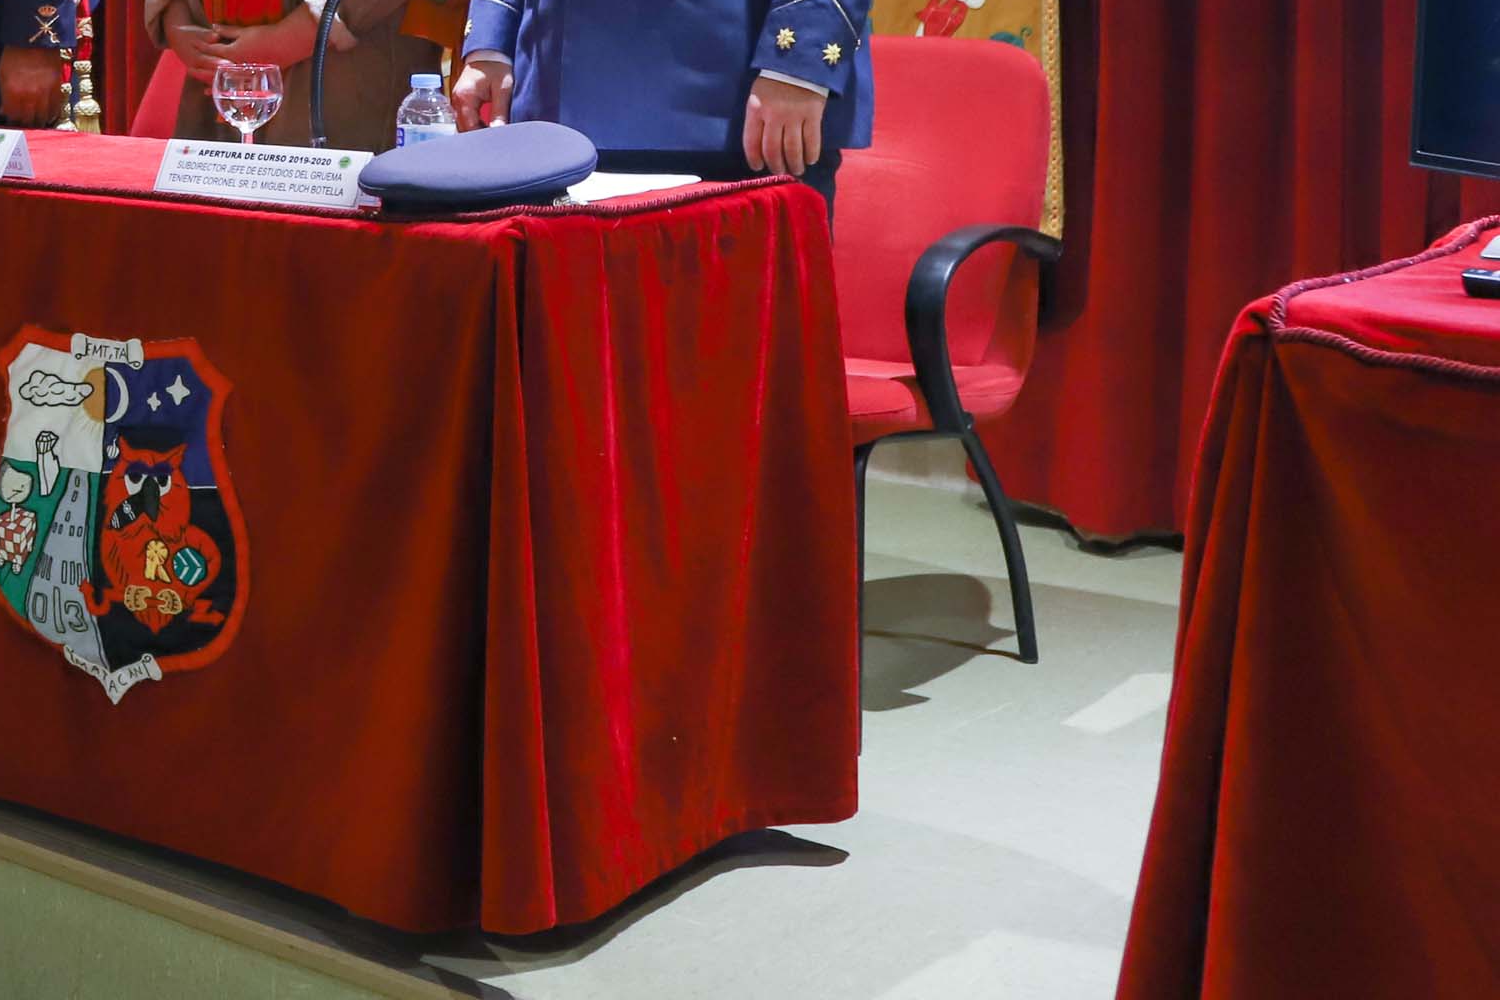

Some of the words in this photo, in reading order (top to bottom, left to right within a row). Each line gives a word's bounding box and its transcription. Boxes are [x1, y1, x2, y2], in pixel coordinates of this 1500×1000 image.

[199, 149, 242, 159] APERTURA
[245, 152, 256, 160] DE
[257, 153, 287, 163] CURSO
[288, 156, 332, 166] 2019-2020
[177, 160, 227, 173] SUBDIRECTOR
[227, 164, 245, 174] JEFE
[245, 165, 257, 175] DE
[257, 167, 294, 178] ESTUDIOS
[294, 170, 308, 179] DEL
[310, 171, 342, 181] GRUEMA
[169, 173, 202, 184] TENIENTE
[202, 176, 236, 187] CORONEL
[260, 181, 287, 191] MIGUEL
[289, 183, 310, 193] PUCH
[310, 185, 344, 197] BOTELLA
